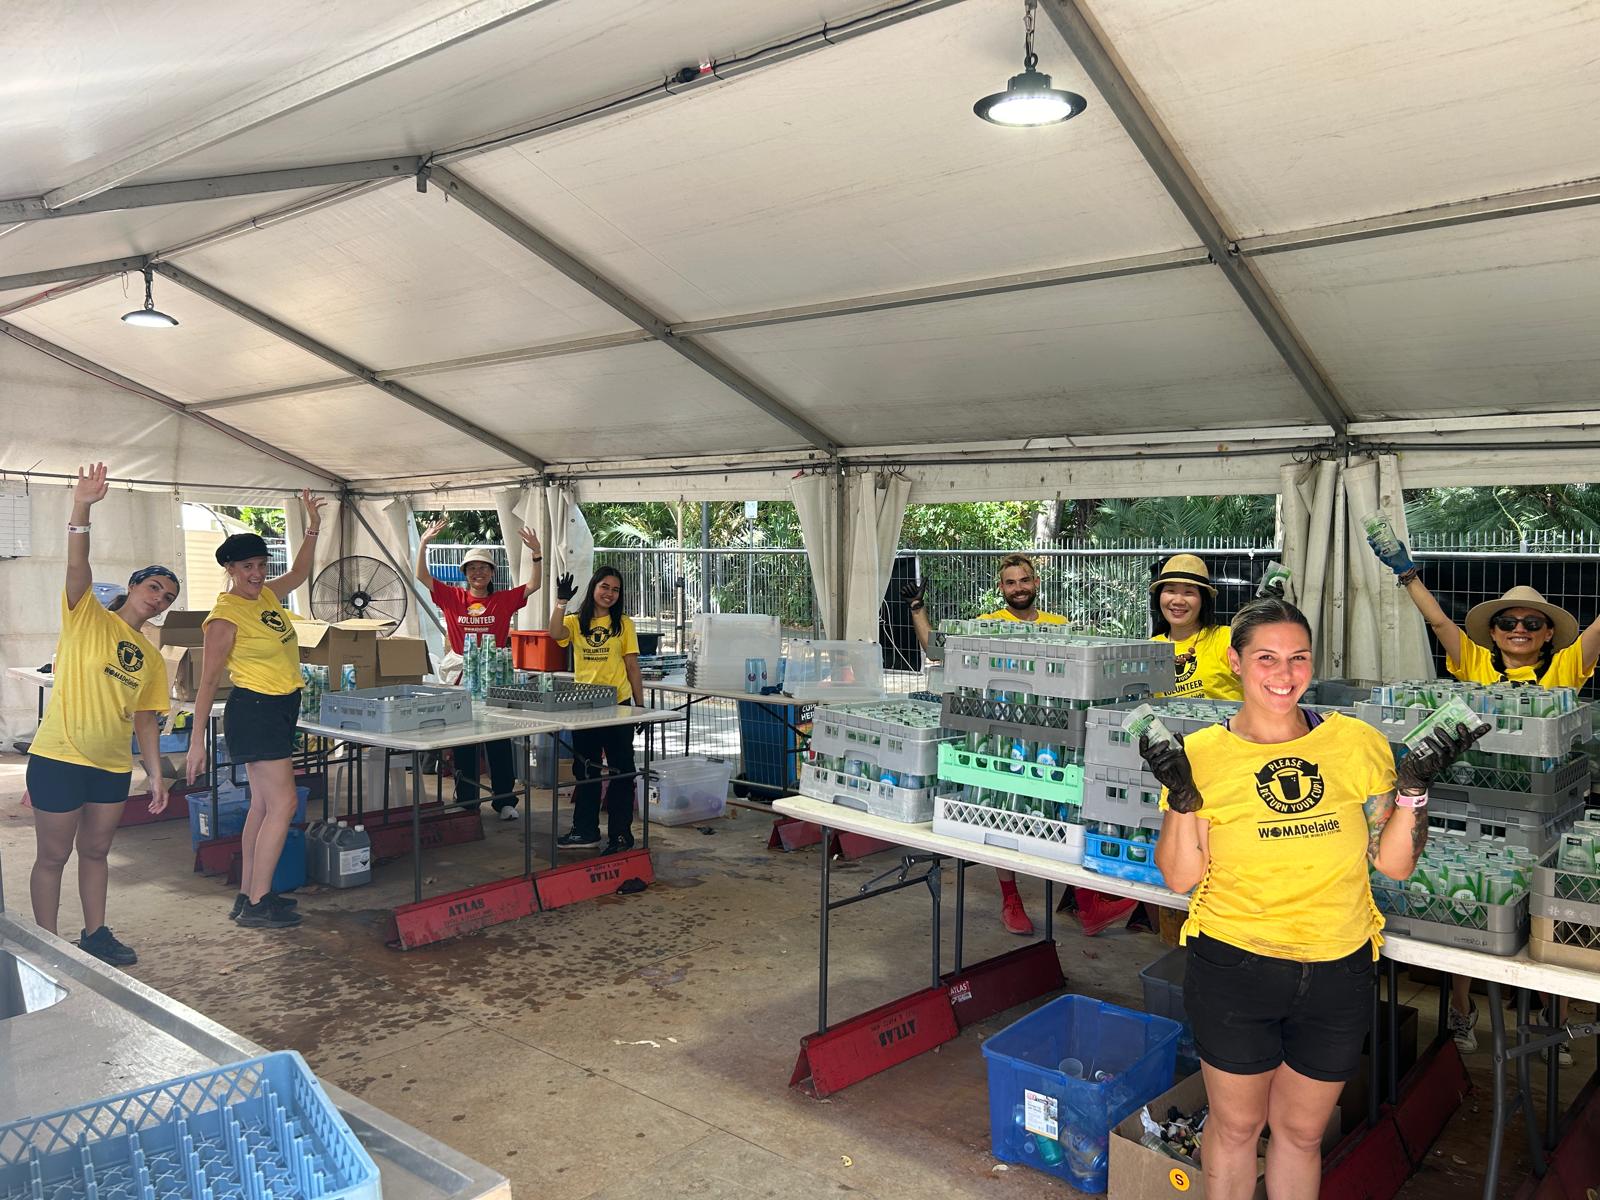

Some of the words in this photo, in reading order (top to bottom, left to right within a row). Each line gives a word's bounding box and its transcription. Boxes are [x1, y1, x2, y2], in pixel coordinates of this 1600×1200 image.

[458, 616, 496, 625] VOLUNTEER
[1267, 758, 1303, 772] PLEASE
[1259, 787, 1289, 812] RETURN
[1290, 797, 1315, 812] YOUR
[1311, 780, 1323, 799] CUP!
[589, 868, 621, 883] ATLAS
[448, 898, 485, 917] ATLAS
[950, 983, 967, 994] ATLAS
[879, 1020, 916, 1047] ATLAS
[1175, 1173, 1184, 1186] S
